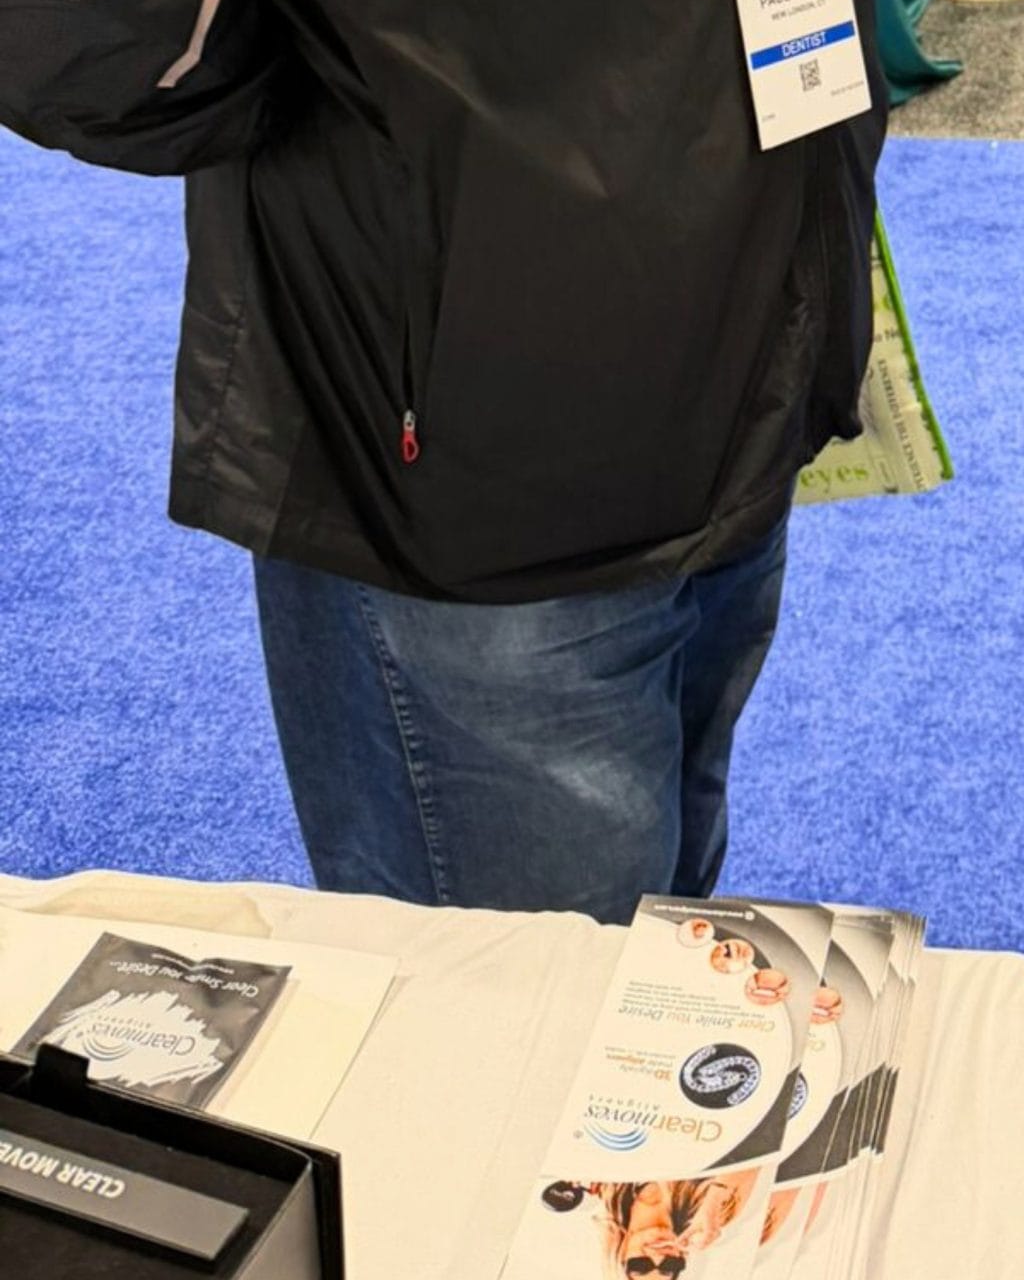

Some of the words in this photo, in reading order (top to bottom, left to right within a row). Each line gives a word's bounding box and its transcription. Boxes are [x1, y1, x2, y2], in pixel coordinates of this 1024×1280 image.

[781, 31, 828, 58] DENTIST
[800, 464, 868, 494] eyes
[221, 978, 259, 998] Clear
[618, 1004, 665, 1023] Desire
[667, 1010, 691, 1025] You
[695, 1014, 735, 1030] Smile
[738, 1017, 775, 1033] Clear
[87, 1022, 196, 1058] Clearmoves
[583, 1103, 723, 1144] Clearmoves
[56, 1162, 125, 1198] CLEAR
